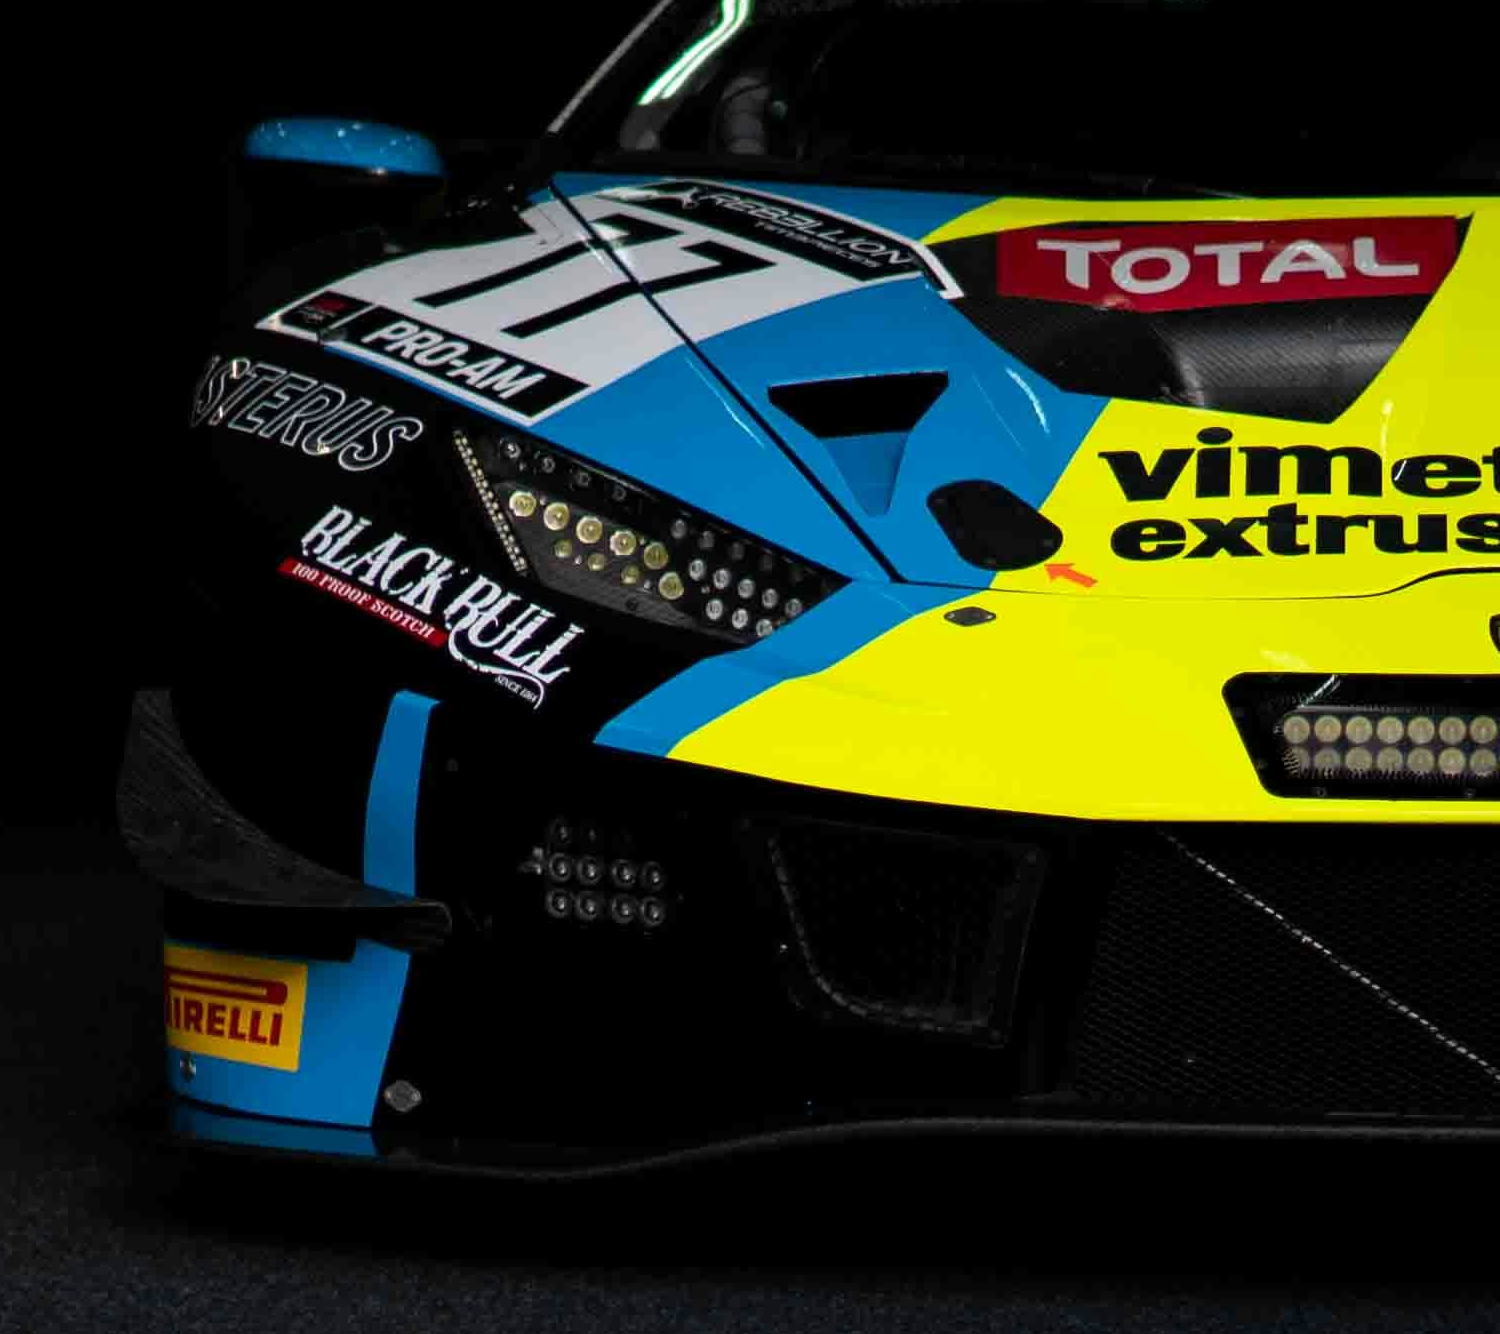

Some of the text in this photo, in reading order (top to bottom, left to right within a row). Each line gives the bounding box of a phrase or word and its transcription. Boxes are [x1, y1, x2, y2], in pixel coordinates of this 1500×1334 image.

[700, 192, 916, 266] REBELLION
[1035, 236, 1422, 294] TOTAL
[411, 212, 780, 339] 77
[360, 318, 548, 401] PRO-AM
[291, 562, 436, 640] 100 PROOF SCOTCH
[301, 505, 586, 684] BLACK BULL
